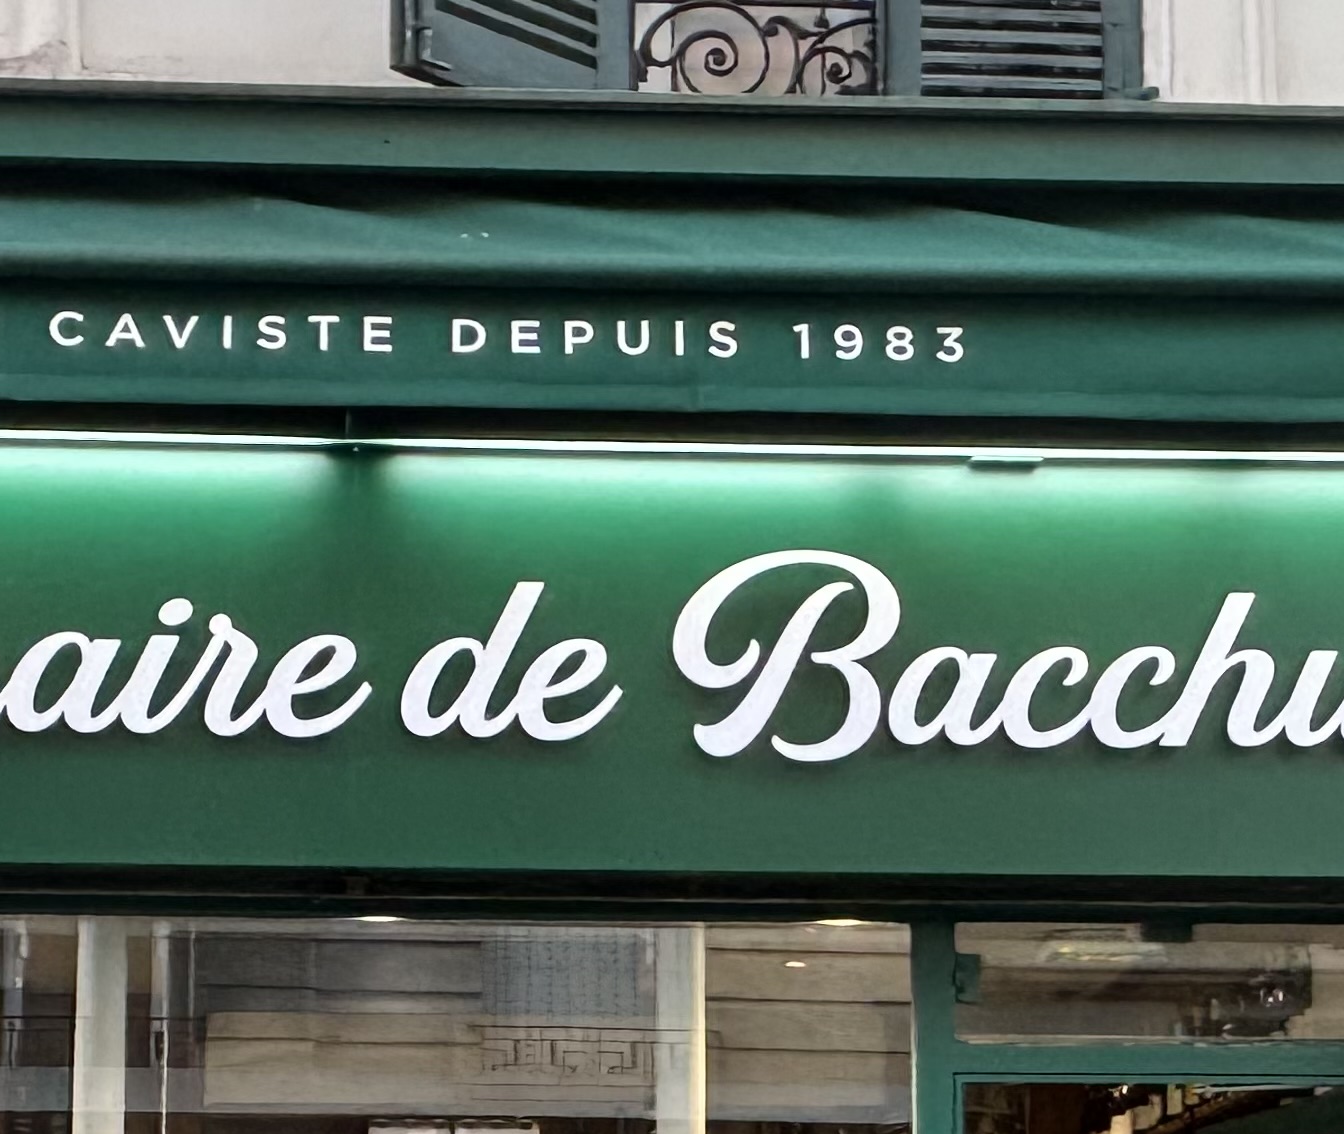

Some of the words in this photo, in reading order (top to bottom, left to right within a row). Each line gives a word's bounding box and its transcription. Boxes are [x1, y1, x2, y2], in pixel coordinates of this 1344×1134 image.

[47, 309, 394, 353] CAVISTE
[450, 317, 739, 358] DEPUIS
[791, 322, 965, 363] 1983
[400, 581, 624, 741] de
